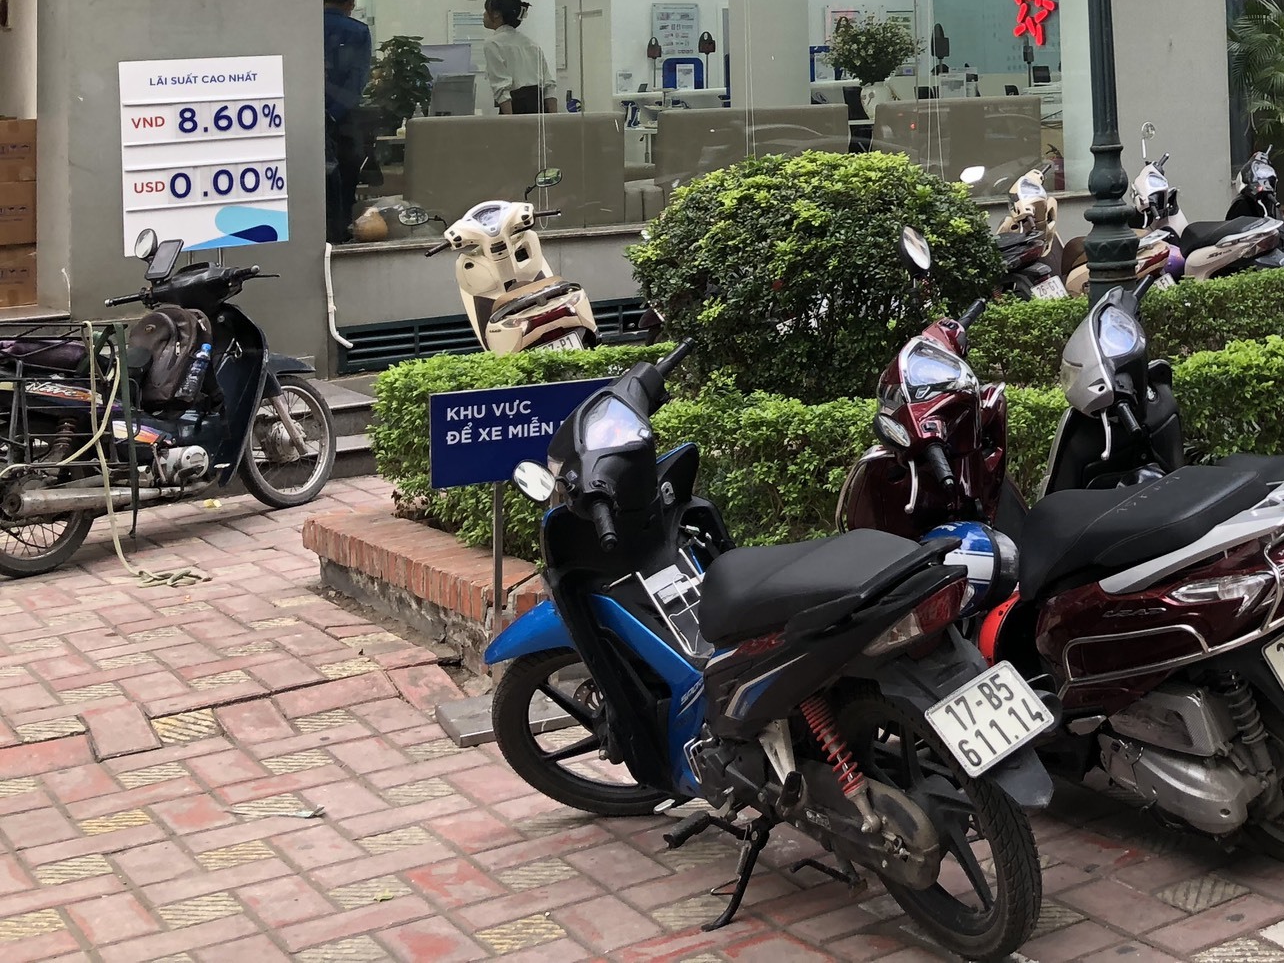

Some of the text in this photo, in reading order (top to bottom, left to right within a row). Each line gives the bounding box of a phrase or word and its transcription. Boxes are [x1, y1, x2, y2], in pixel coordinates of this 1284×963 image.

[150, 71, 258, 86] LÃI SUẤT CAO NHẤT
[131, 103, 282, 133] VND 8.60%
[134, 181, 166, 193] USD
[446, 399, 532, 421] KHU VỰC
[446, 417, 554, 445] ĐỂ XE MIỄN
[944, 673, 1014, 731] 17-B5
[958, 698, 1044, 767] 611.14
